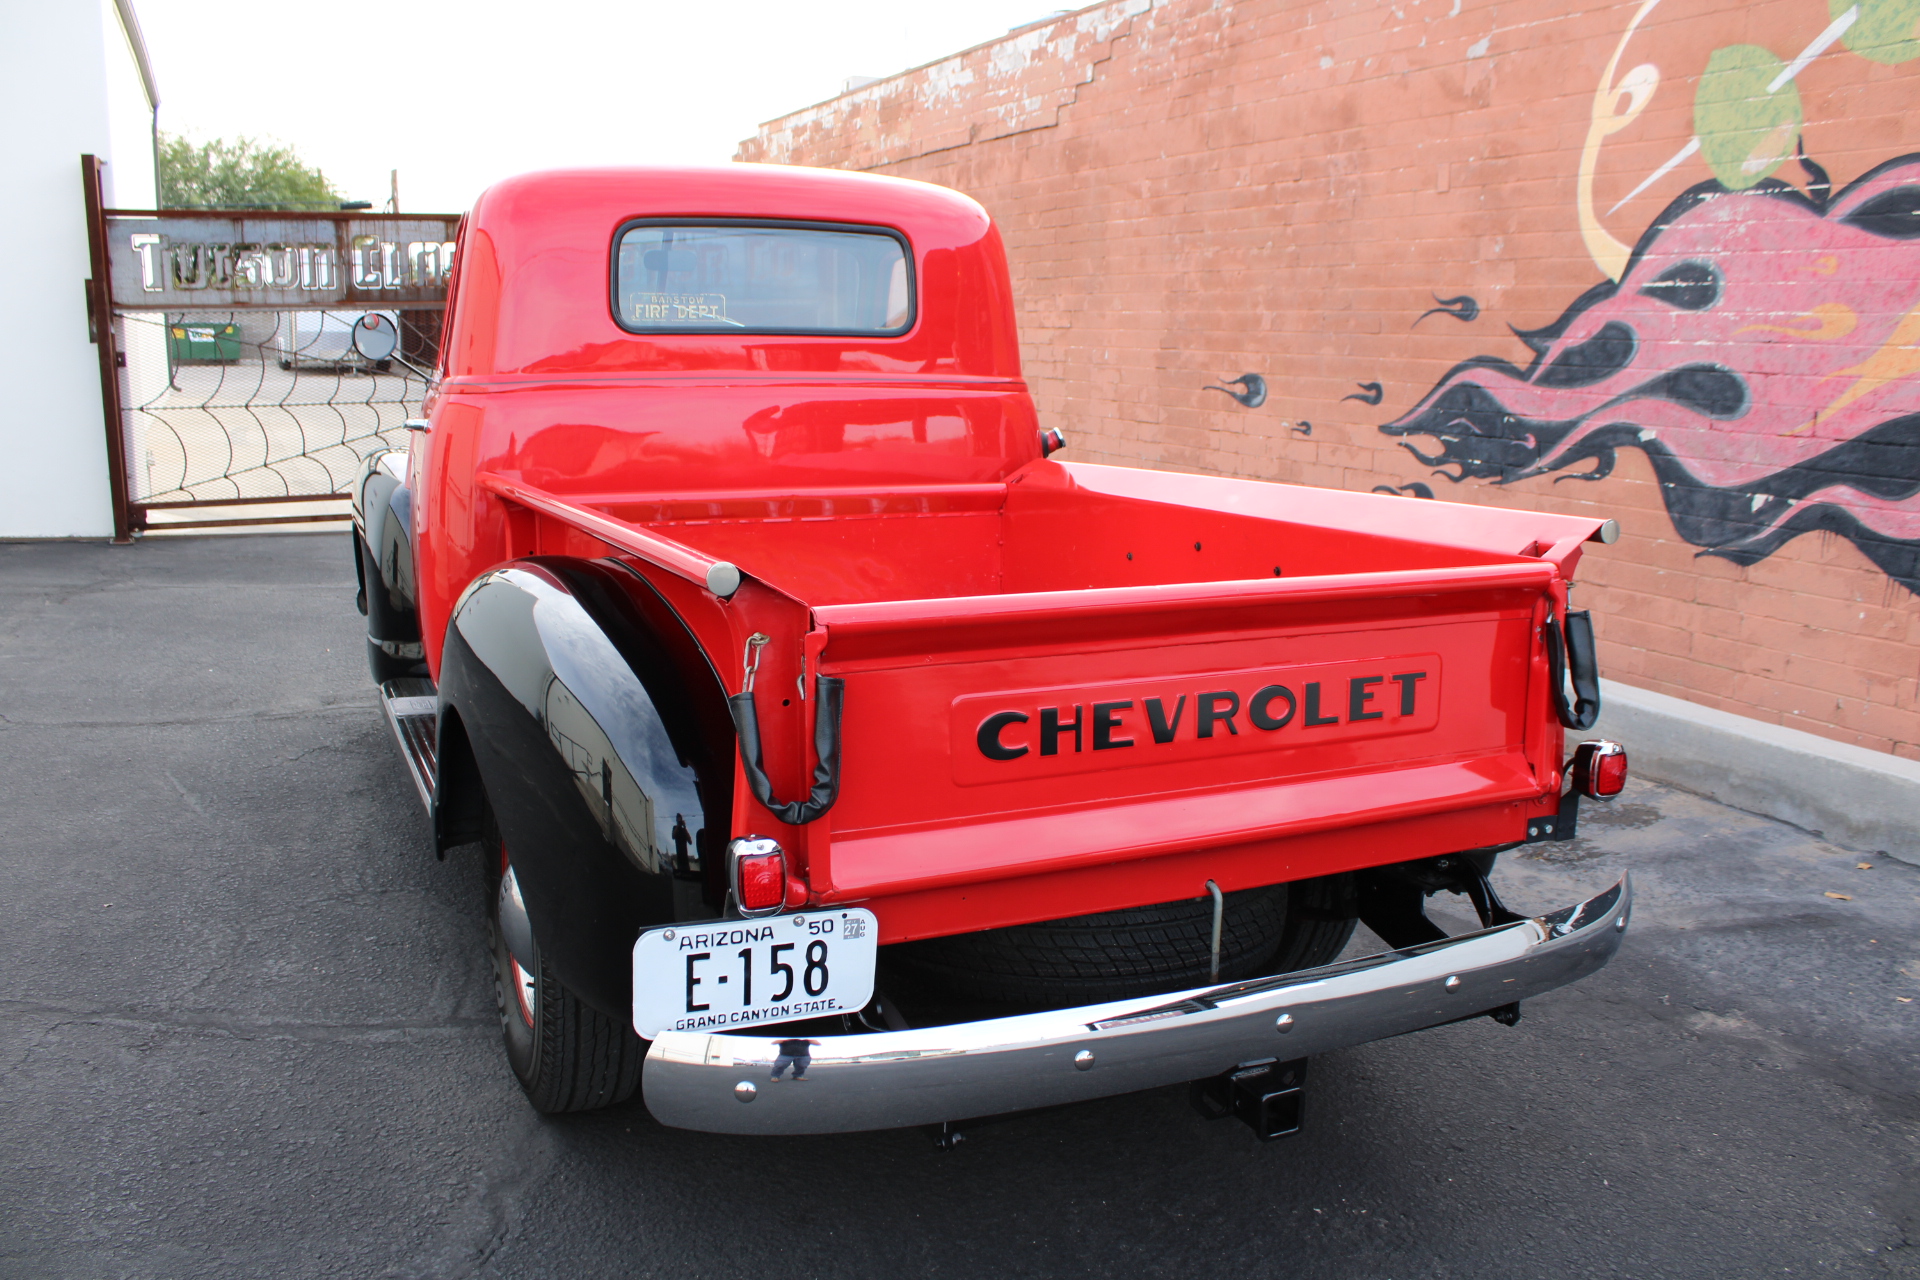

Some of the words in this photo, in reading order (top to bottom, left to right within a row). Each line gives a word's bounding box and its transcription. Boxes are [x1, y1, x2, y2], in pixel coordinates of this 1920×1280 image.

[635, 304, 670, 318] FIRE
[651, 295, 704, 304] BARSTOW
[976, 671, 1427, 761] CHEVROLET
[679, 926, 774, 951] ARIZONA
[808, 919, 834, 935] 50
[845, 923, 858, 936] 27
[686, 939, 829, 1013] E-158
[676, 1013, 726, 1031] GRAND
[730, 1004, 790, 1024] CANYON
[793, 998, 836, 1014] STATE
